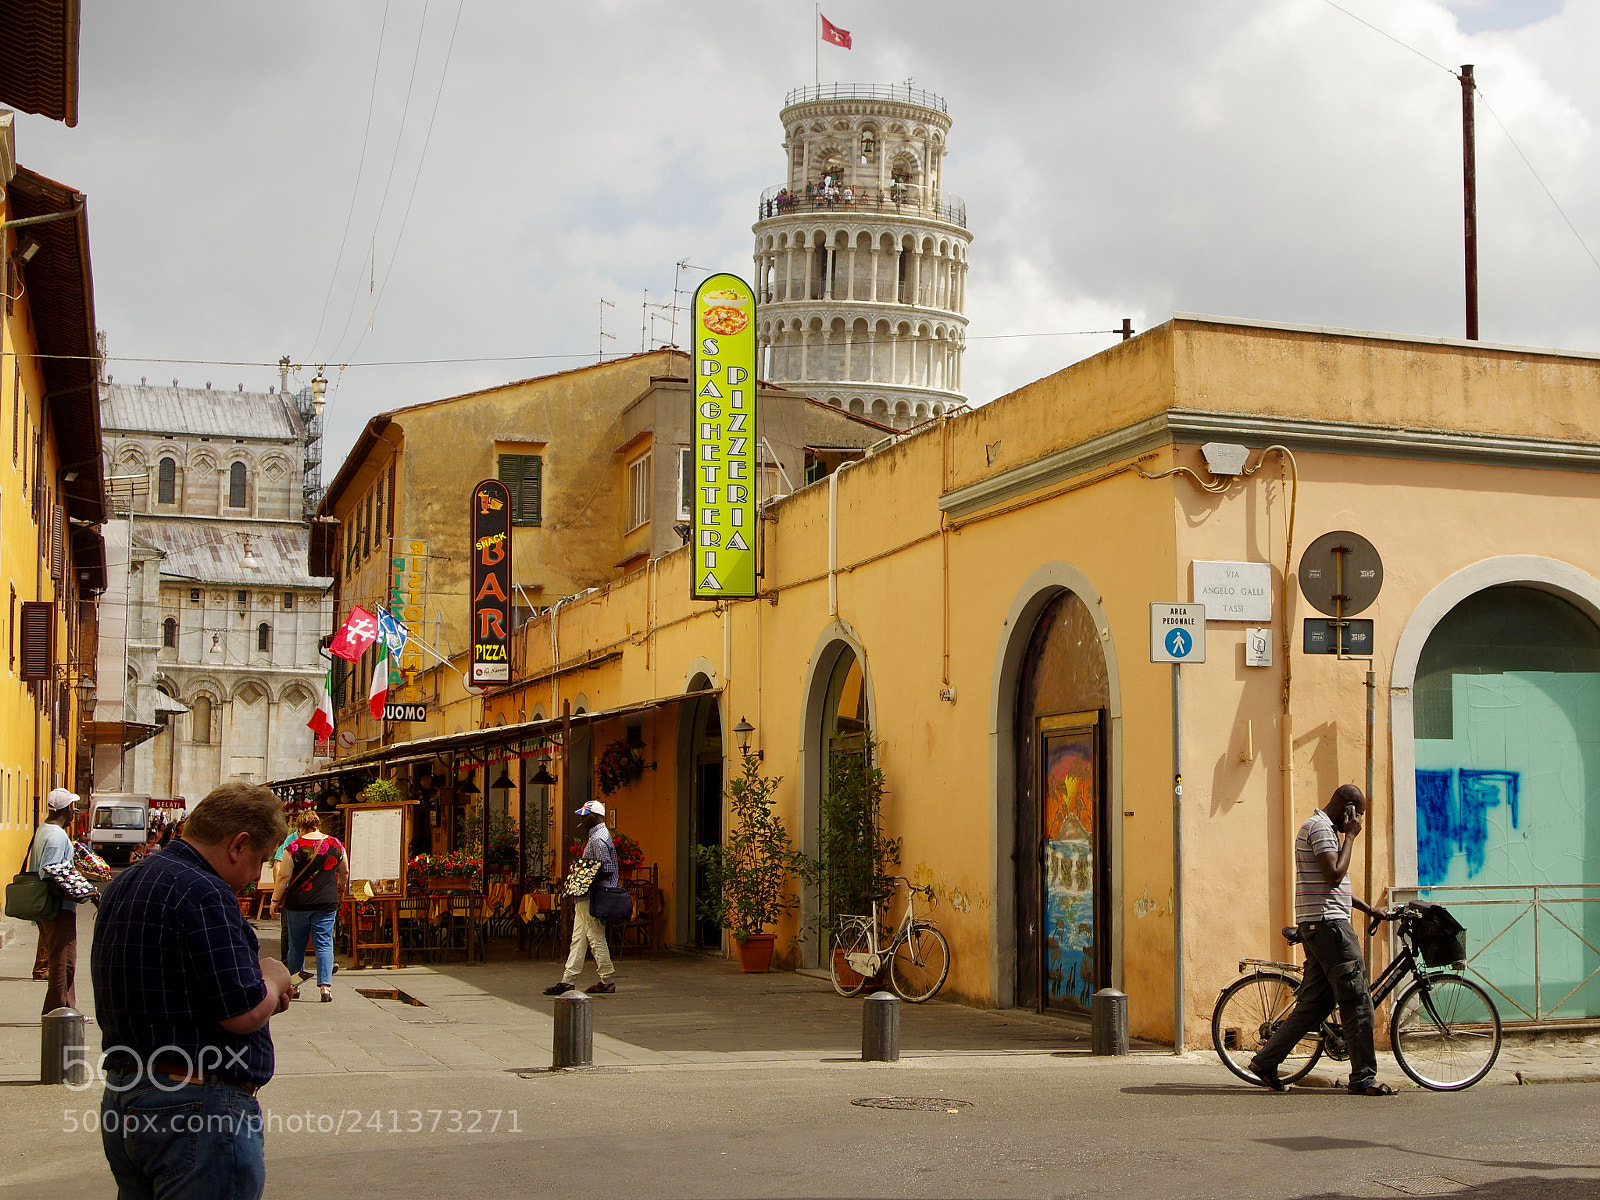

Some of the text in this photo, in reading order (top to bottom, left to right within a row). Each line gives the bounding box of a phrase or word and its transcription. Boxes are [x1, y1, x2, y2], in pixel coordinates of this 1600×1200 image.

[699, 338, 723, 590] SPAGHETTERIA
[725, 366, 750, 551] PIZZERIA
[475, 531, 507, 551] SNACK
[1226, 571, 1240, 579] VIA
[475, 536, 508, 639] BAR
[1202, 587, 1264, 596] ANGELO GALLI
[1170, 607, 1187, 616] AREA
[1222, 605, 1244, 613] TASSI
[1162, 617, 1195, 626] PEDONALE
[475, 644, 507, 661] PIZZA
